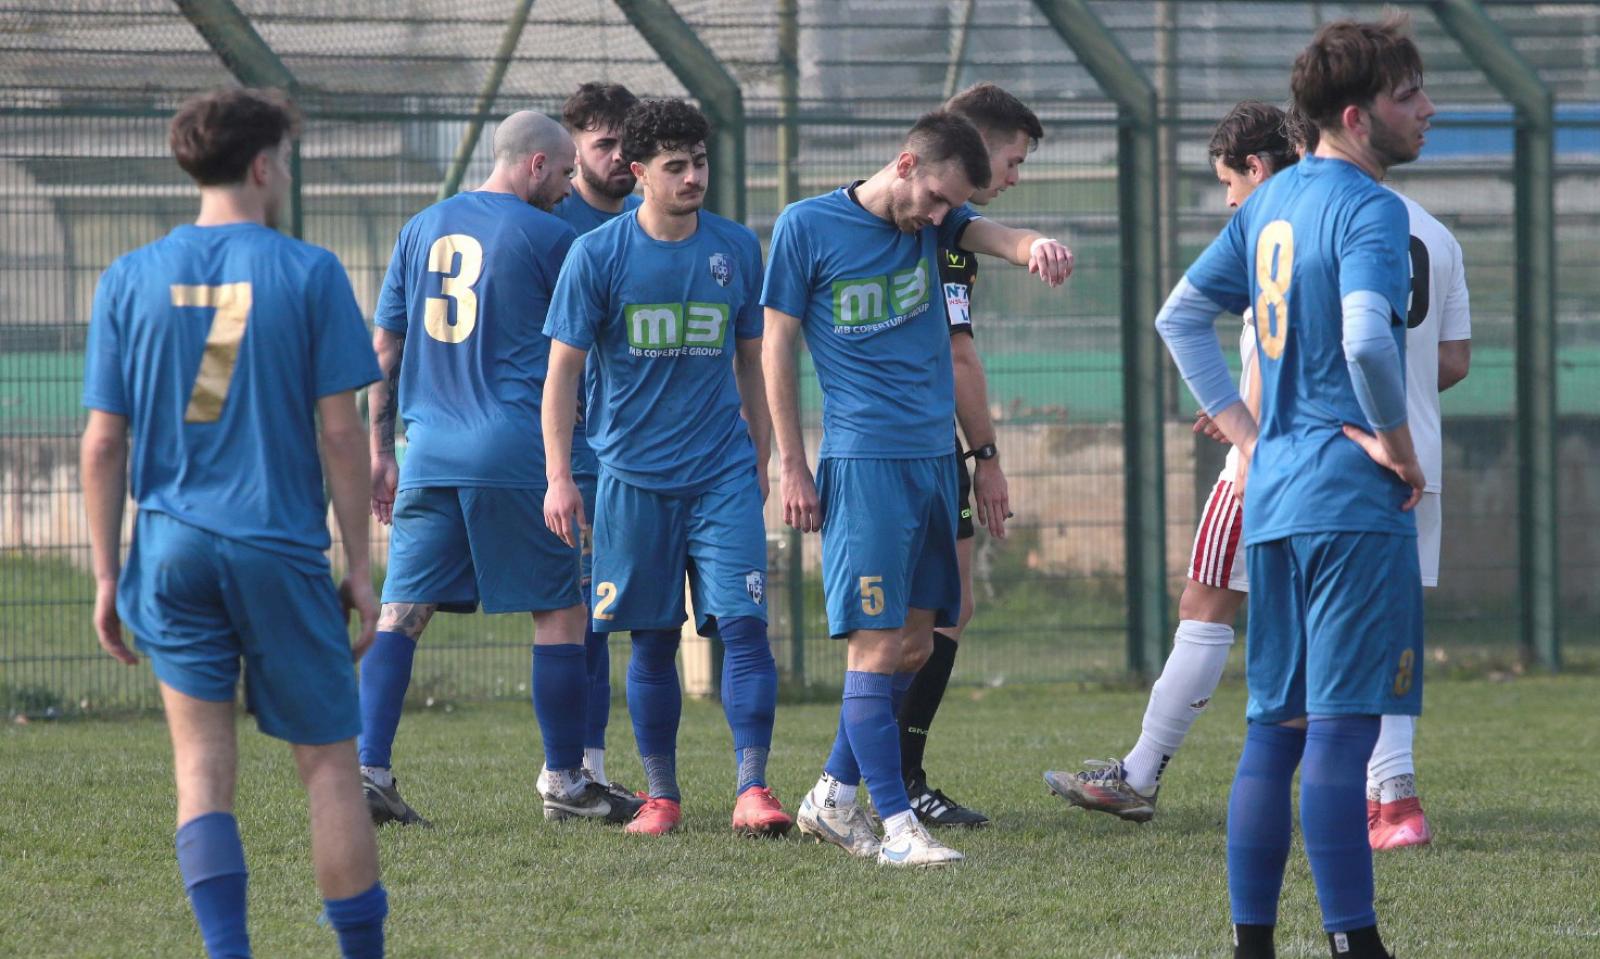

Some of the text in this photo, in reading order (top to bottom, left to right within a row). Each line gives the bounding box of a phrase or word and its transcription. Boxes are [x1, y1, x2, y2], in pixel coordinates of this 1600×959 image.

[424, 234, 483, 344] 3
[1256, 220, 1294, 360] 8
[834, 326, 850, 334] MB
[170, 282, 252, 423] 7
[629, 346, 642, 357] MB
[689, 347, 722, 357] GROUP
[593, 582, 617, 620] 2
[859, 577, 884, 616] 5
[1395, 648, 1414, 694] 8
